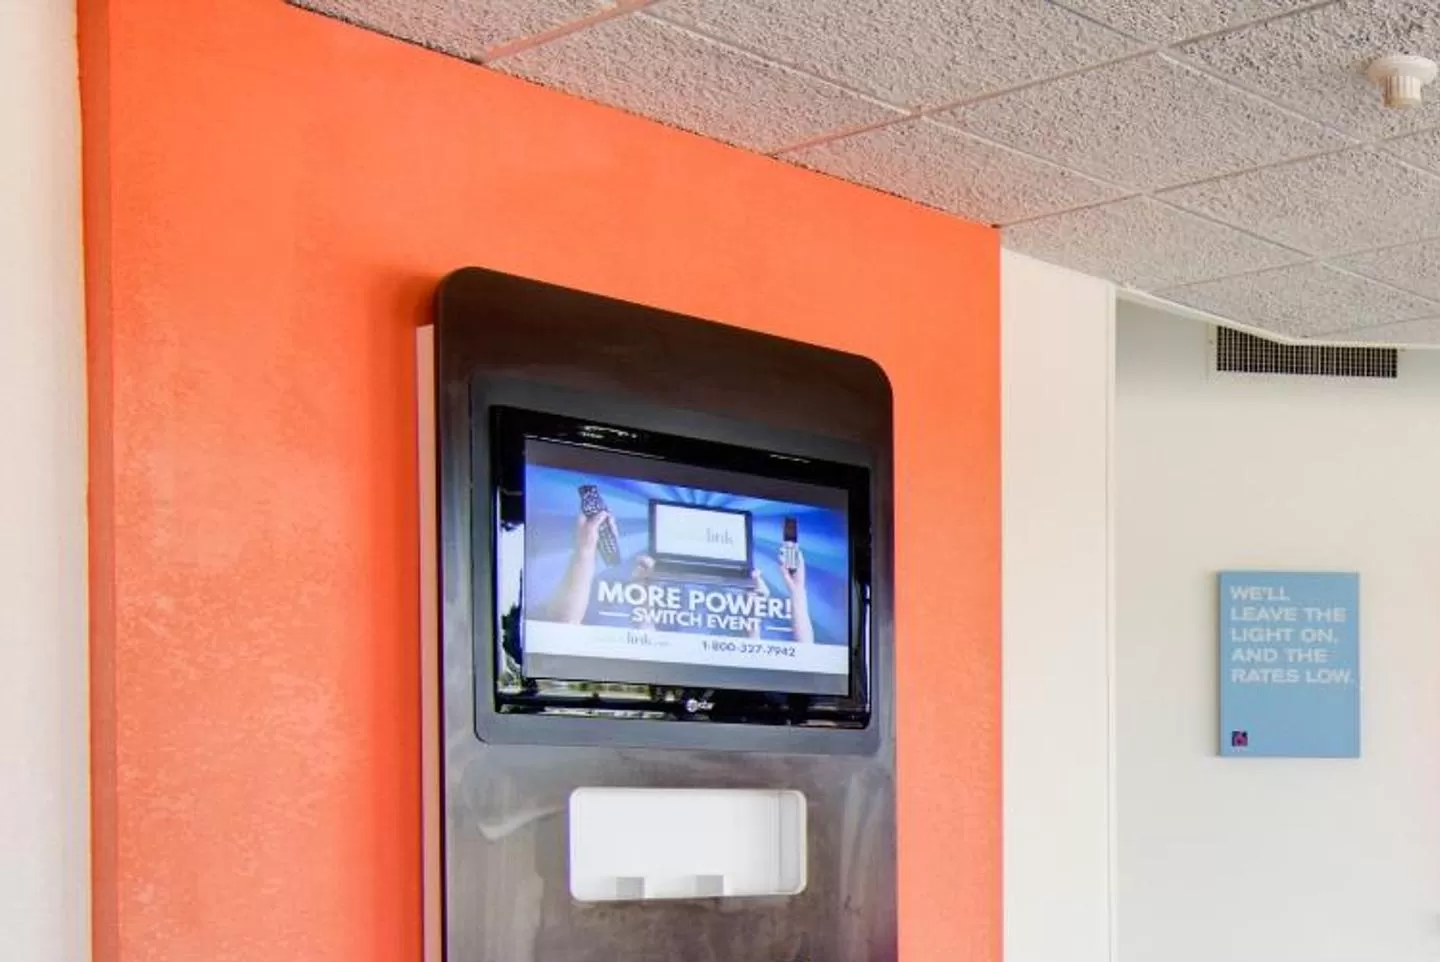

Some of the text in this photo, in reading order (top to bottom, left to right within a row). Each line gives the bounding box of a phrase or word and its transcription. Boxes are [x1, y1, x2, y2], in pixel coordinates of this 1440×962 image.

[597, 581, 792, 619] MORE POWER!
[1230, 586, 1290, 601] WE'LL
[632, 607, 762, 632] SWITCH EVENT
[1231, 607, 1346, 622] LEAVE THE
[1231, 628, 1294, 643] LIGHT
[701, 641, 796, 657] 1-800-327-7942
[1231, 648, 1329, 663] AND THE
[1232, 668, 1299, 683] RATES
